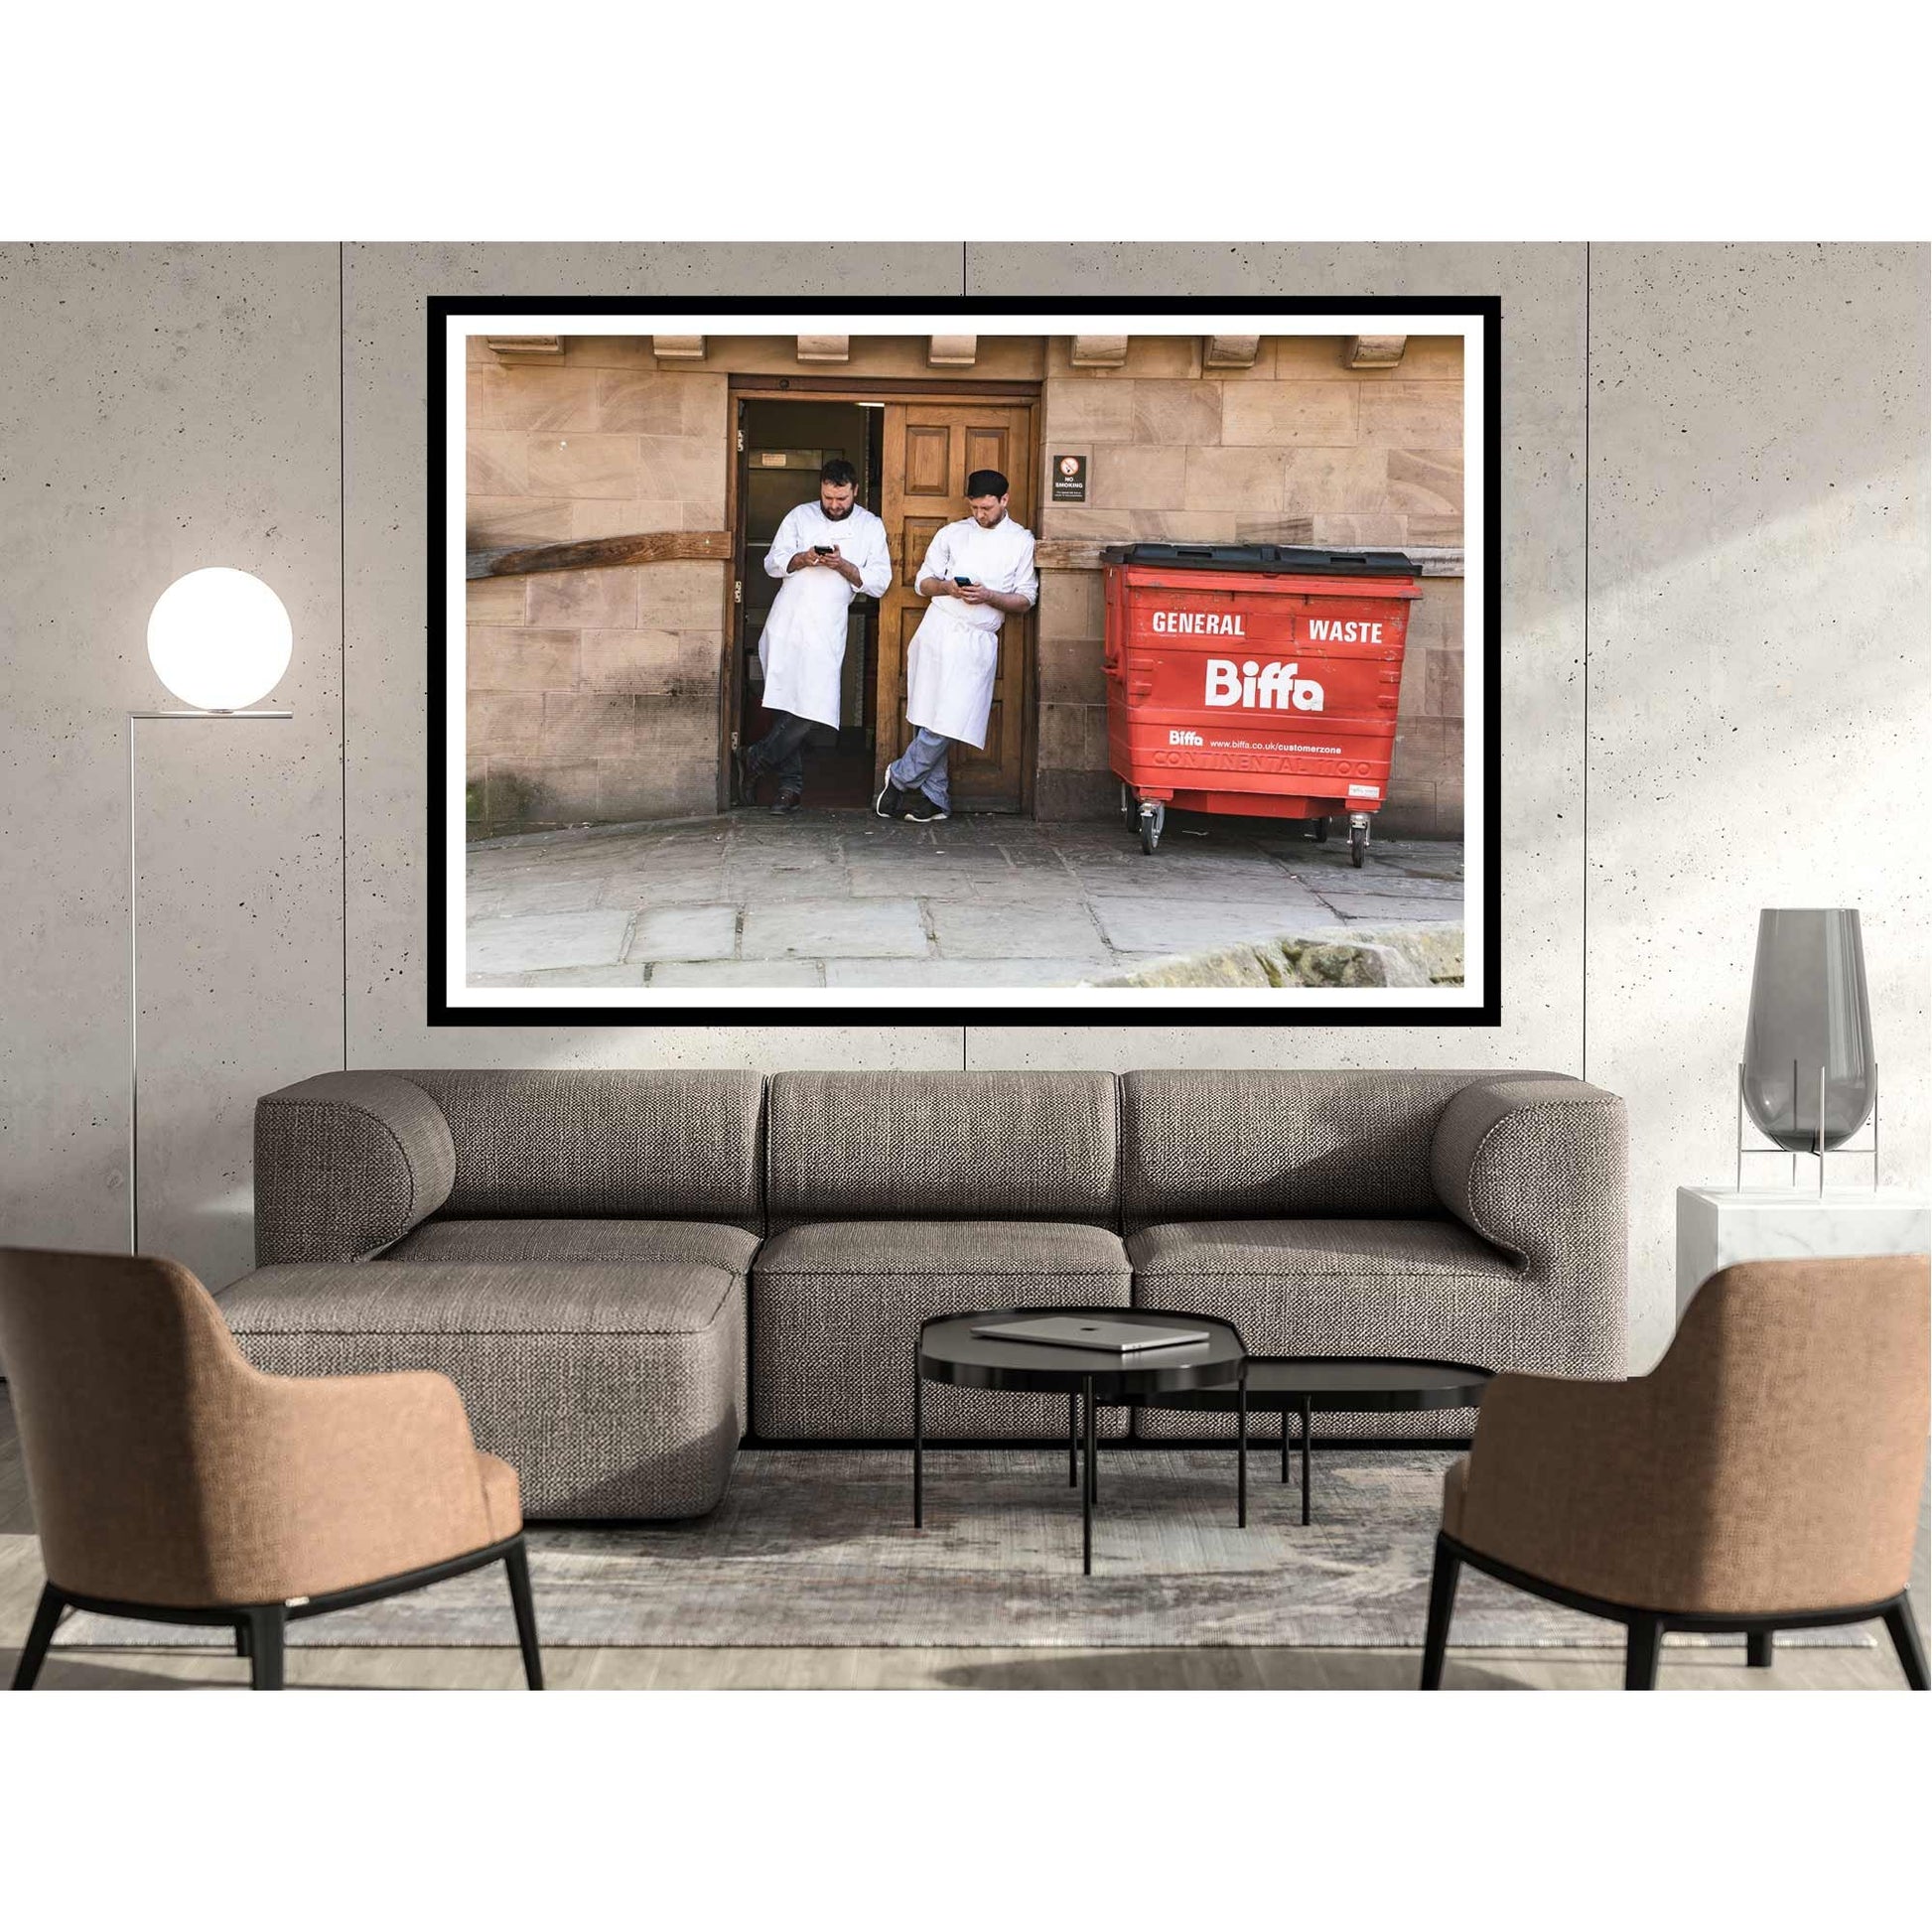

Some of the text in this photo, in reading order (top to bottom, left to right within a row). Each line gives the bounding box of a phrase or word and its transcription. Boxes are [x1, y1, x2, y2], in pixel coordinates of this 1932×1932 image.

[1152, 611, 1383, 644] GENERAL WASTE
[1204, 658, 1324, 712] Biffa
[1169, 730, 1342, 756] Biffa www.biffa.co.uk/customerzone
[1152, 751, 1308, 773] CONTINENTAL
